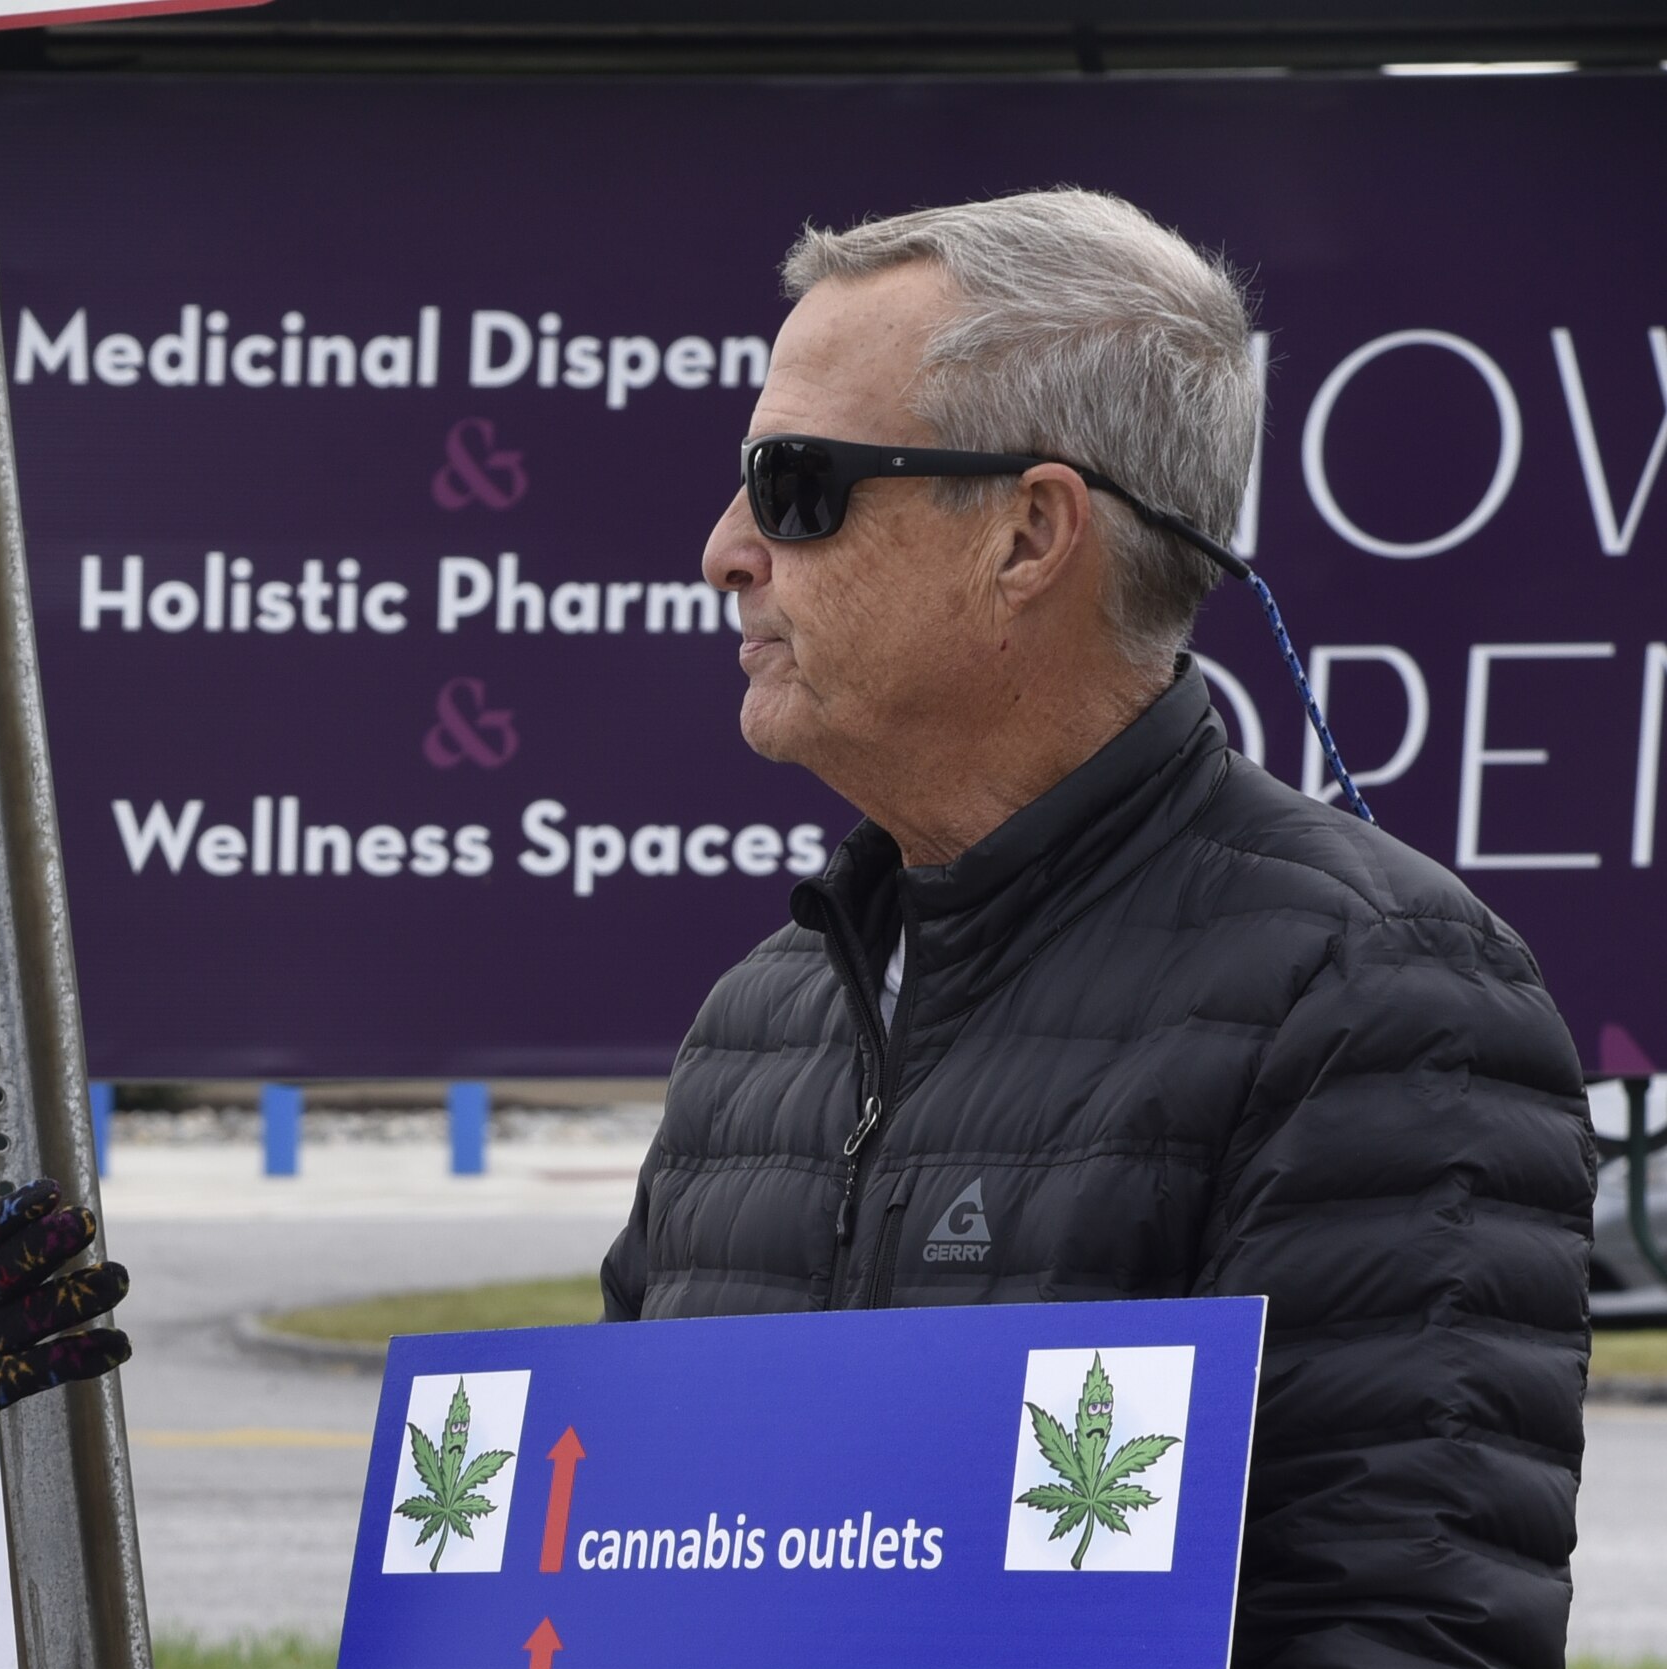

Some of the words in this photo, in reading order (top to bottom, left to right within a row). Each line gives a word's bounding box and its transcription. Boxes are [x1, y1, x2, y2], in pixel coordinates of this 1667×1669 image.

[14, 304, 439, 387] Medicinal
[432, 417, 529, 511] &
[80, 551, 407, 633] Holistic
[438, 552, 743, 633] Pharm
[422, 677, 520, 771] &
[1197, 643, 1667, 868] PE
[112, 796, 493, 876] Wellness
[519, 799, 826, 896] Spaces
[923, 1244, 991, 1262] GERRY
[577, 1512, 766, 1571] cannabis
[777, 1510, 944, 1570] outlets
